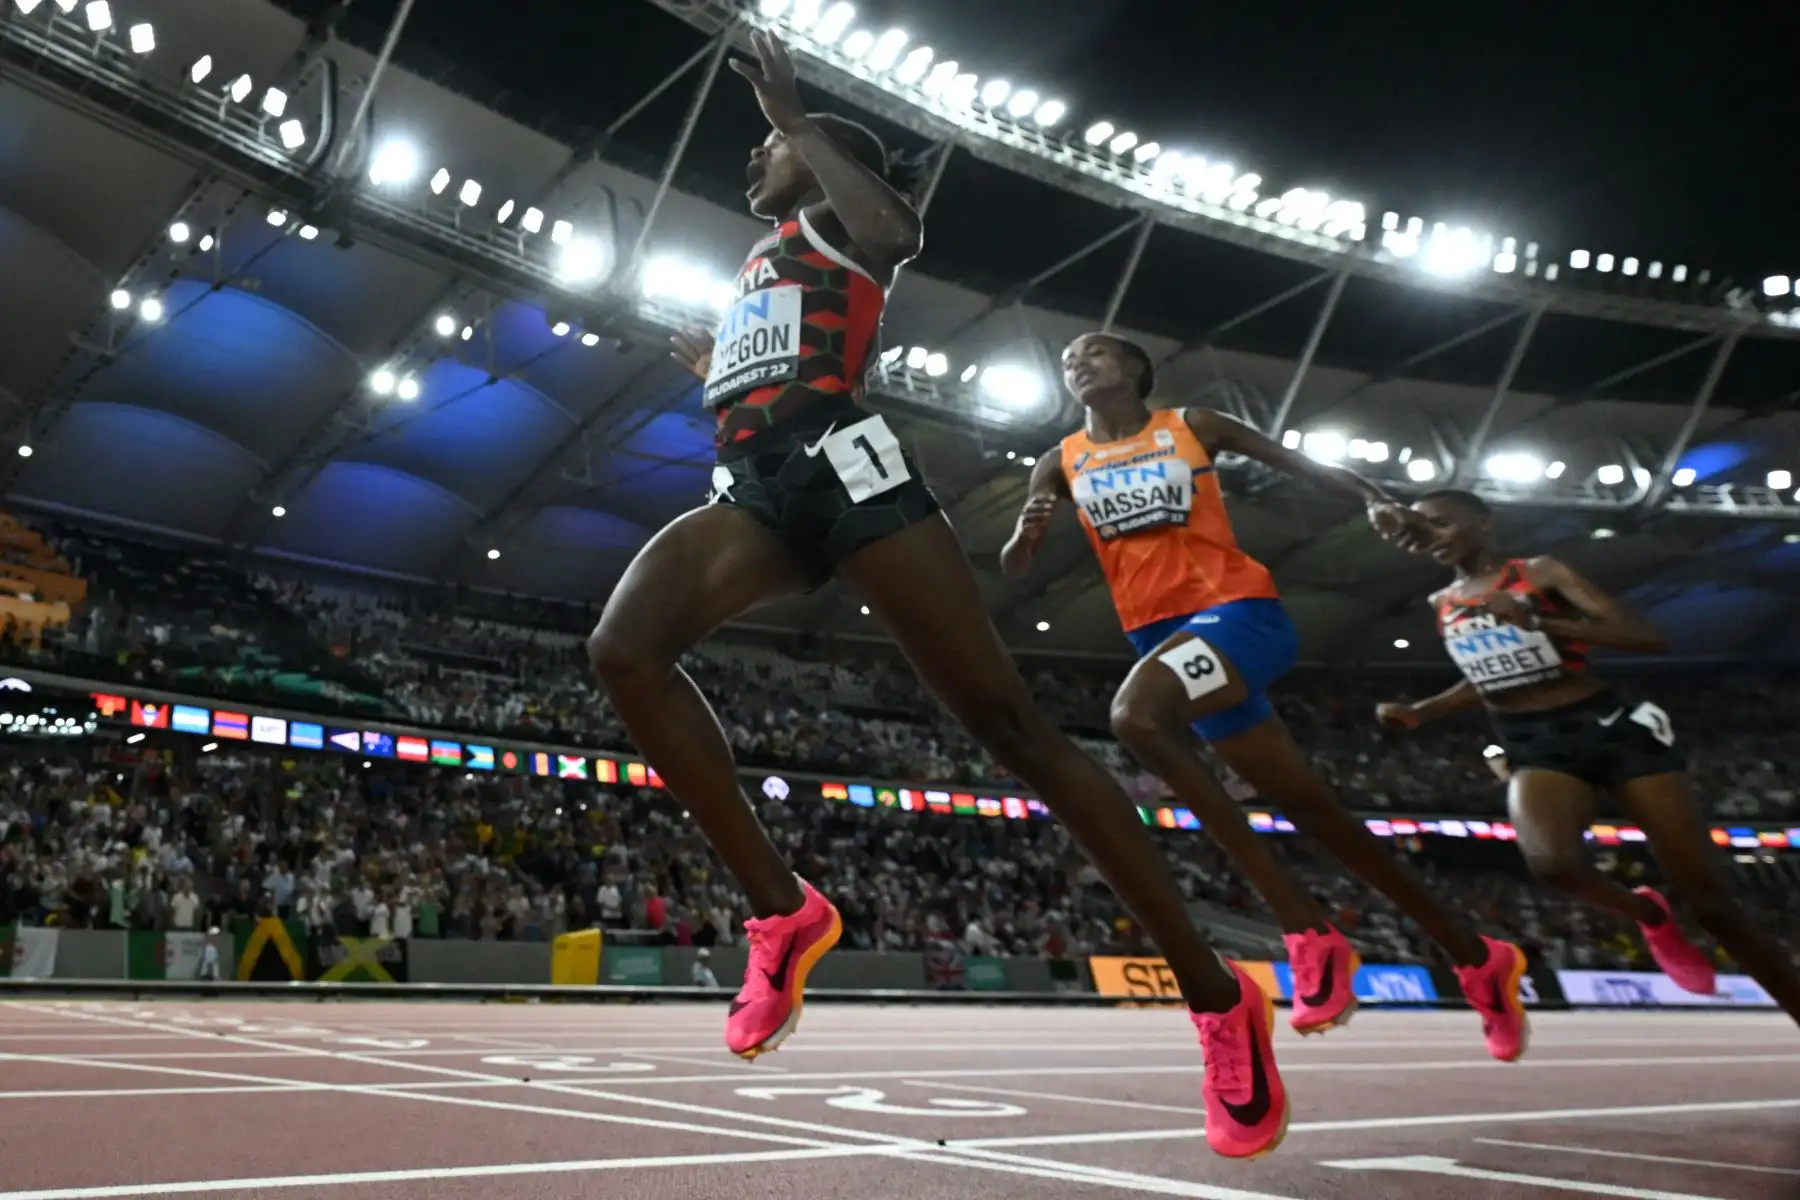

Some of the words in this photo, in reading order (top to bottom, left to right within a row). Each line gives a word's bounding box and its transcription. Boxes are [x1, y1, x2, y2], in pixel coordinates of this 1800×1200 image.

[707, 366, 768, 400] BUDAPEST
[852, 433, 889, 480] 1
[1089, 462, 1167, 494] NTN
[1086, 485, 1183, 522] HASSAN
[1454, 624, 1523, 656] NTN
[1183, 654, 1215, 680] 8
[1466, 645, 1548, 678] HEBET
